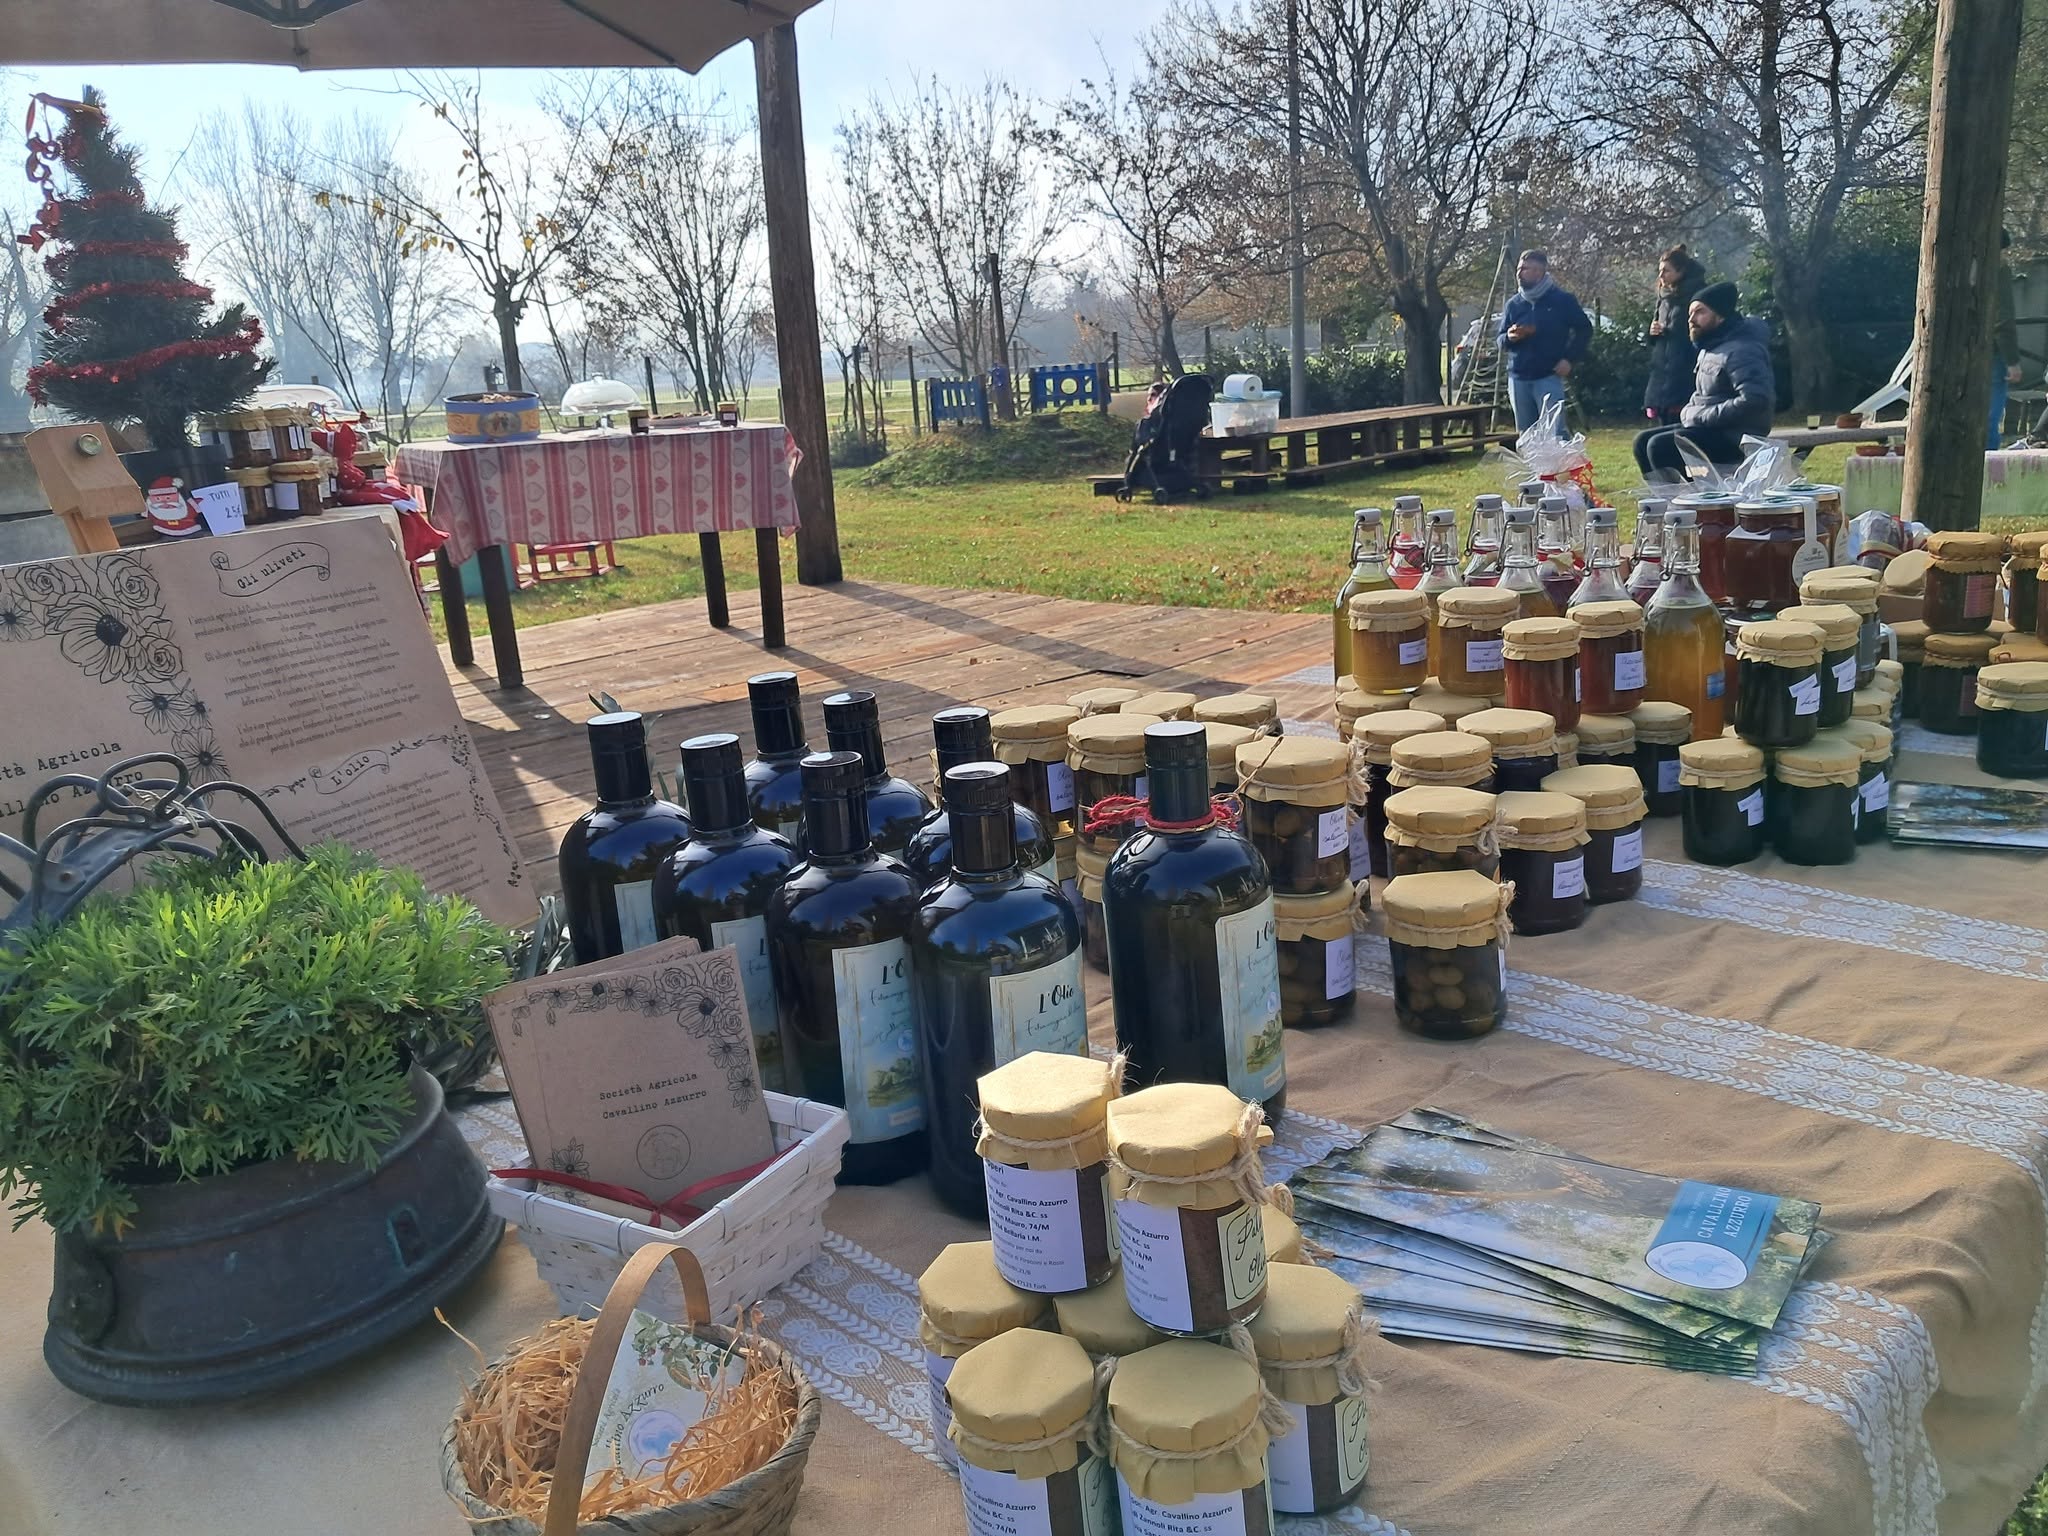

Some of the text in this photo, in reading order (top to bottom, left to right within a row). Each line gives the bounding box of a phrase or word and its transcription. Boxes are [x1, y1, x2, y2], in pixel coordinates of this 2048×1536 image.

[237, 547, 306, 589] Gli uliveti
[37, 741, 122, 770] Agricola
[331, 755, 371, 786] L'olio
[600, 1073, 698, 1101] Società Agricola
[602, 1090, 707, 1119] Cavallino Azzurro
[1006, 1194, 1037, 1207] Cavallino
[1038, 1199, 1068, 1207] Azzurro
[1697, 1187, 1732, 1239] CAVALLINO
[1028, 1222, 1050, 1231] 74/M
[1723, 1195, 1752, 1238] AZZURRO
[1141, 1230, 1169, 1241] Azzurro
[621, 1382, 665, 1422] Azzurro
[974, 1491, 1004, 1508] Cavallino
[1145, 1505, 1160, 1515] Agr.
[1161, 1511, 1200, 1520] Cavallino
[1202, 1505, 1233, 1519] Azzurro
[995, 1524, 1017, 1535] 74/M
[1139, 1514, 1166, 1529] Zannoli
[1167, 1524, 1184, 1534] Rita
